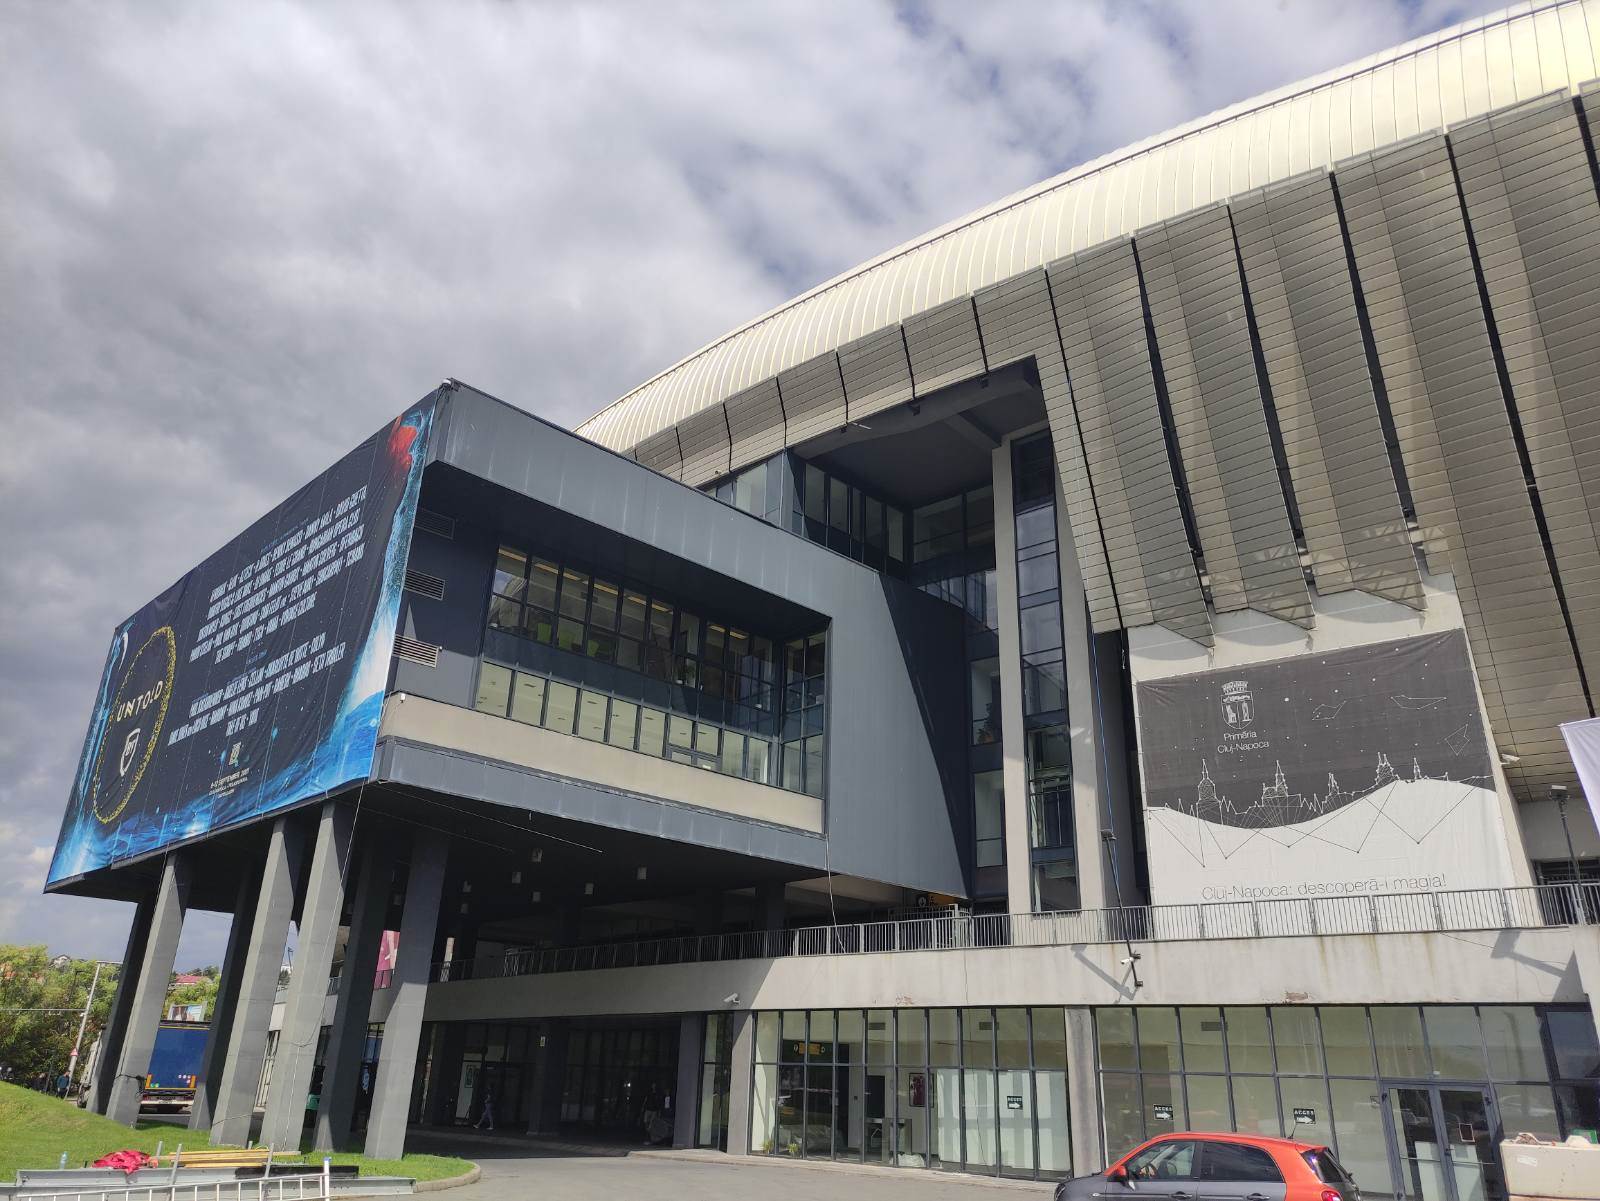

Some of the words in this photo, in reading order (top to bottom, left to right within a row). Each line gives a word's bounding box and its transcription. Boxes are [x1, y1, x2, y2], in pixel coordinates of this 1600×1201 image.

[117, 681, 163, 722] UNTOLD
[1217, 741, 1270, 754] Cluj-Napoca
[1201, 886, 1292, 901] Cluj-Napoca:
[1394, 874, 1447, 891] magia!
